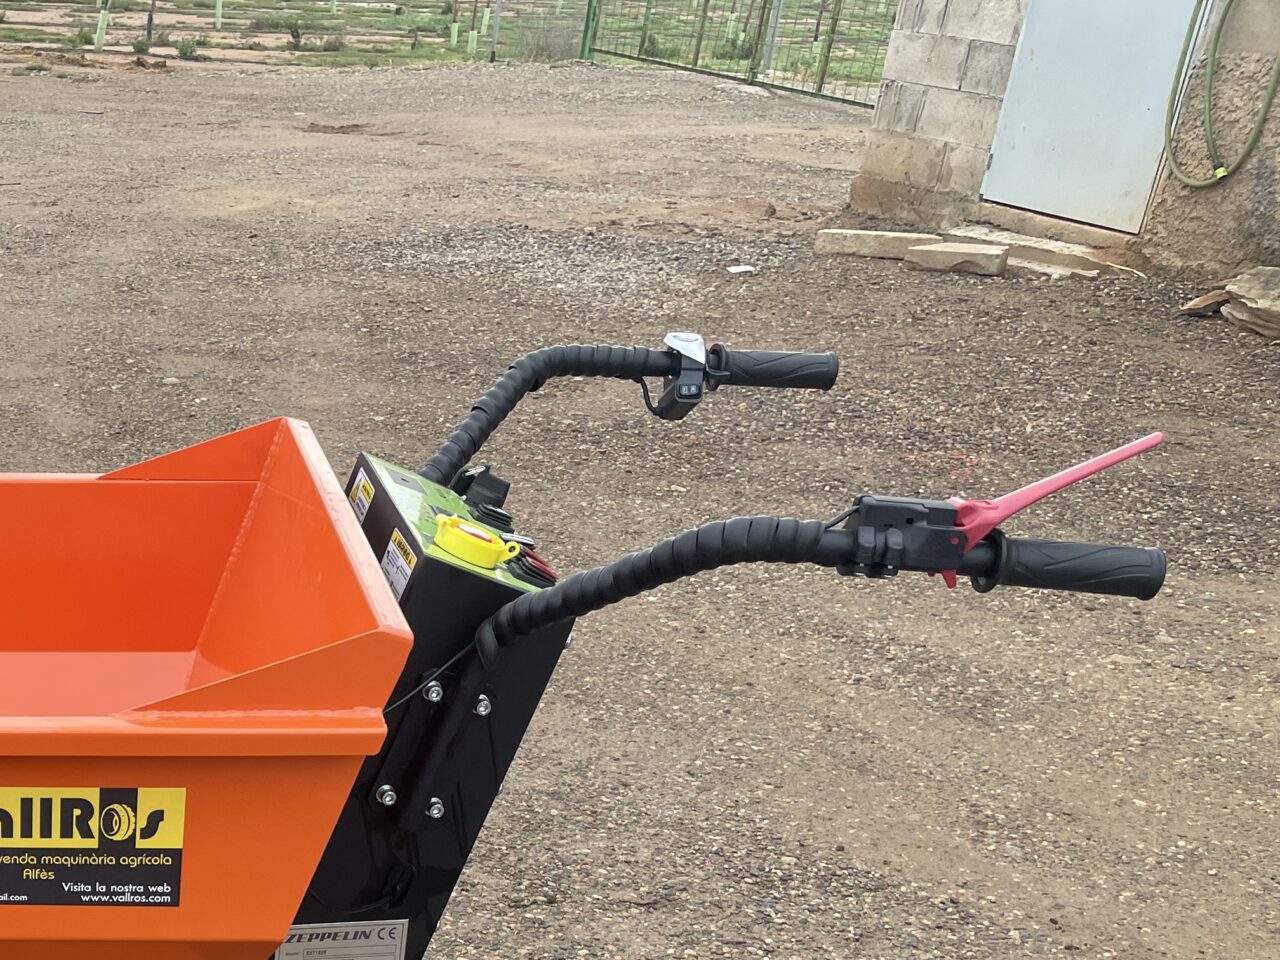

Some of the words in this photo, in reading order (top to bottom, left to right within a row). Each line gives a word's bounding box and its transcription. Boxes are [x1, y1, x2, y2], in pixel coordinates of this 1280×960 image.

[41, 853, 115, 867] maquinària
[119, 853, 172, 867] agrícola
[23, 868, 55, 880] Alfès
[62, 882, 91, 892] Visita
[96, 882, 106, 892] la
[110, 884, 144, 892] nostra
[148, 883, 171, 892] web
[81, 893, 171, 903] www.vallros.com
